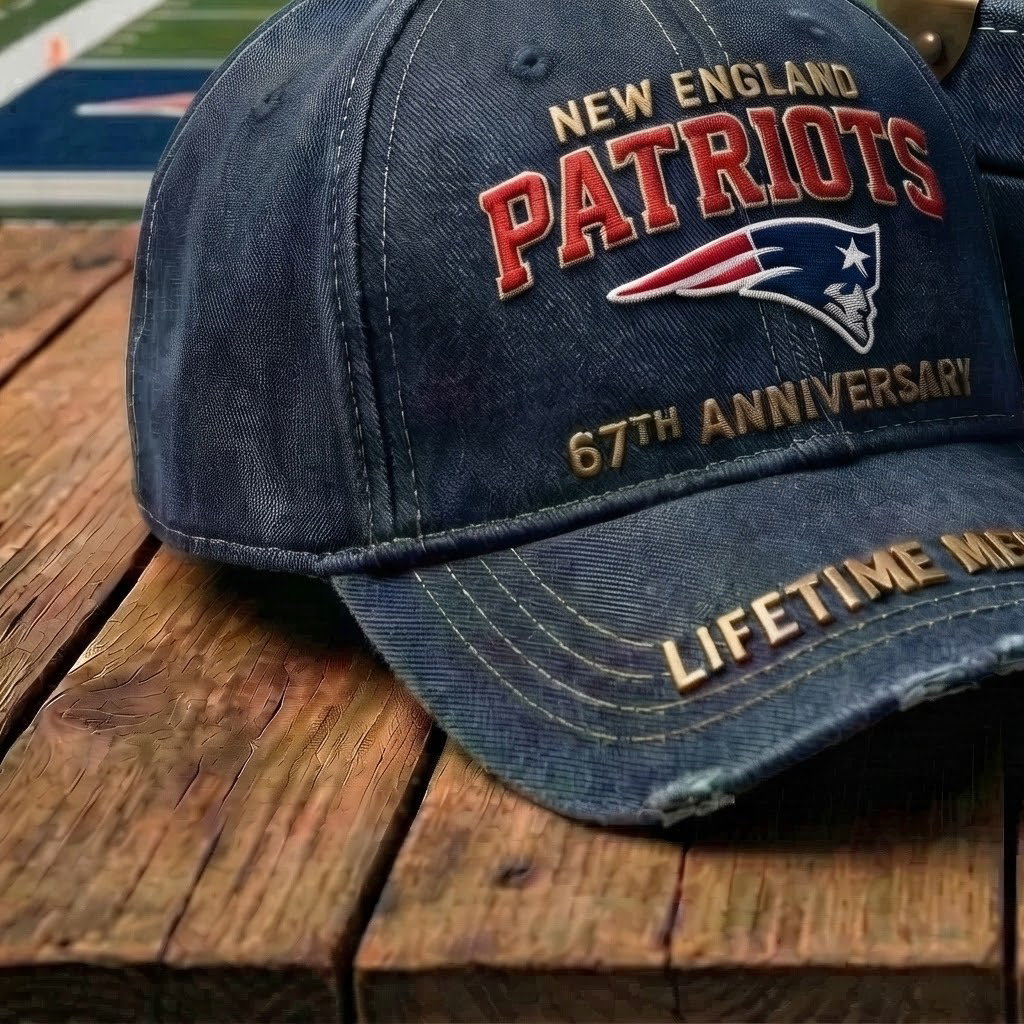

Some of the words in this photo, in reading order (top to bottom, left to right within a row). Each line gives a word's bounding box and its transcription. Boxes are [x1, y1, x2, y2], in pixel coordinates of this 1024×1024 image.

[548, 78, 655, 144] NEW
[669, 59, 860, 108] ENGLAND
[478, 103, 946, 301] PATRIOTS
[568, 405, 684, 478] 67TH
[700, 357, 972, 445] ANNIVERSARY
[661, 540, 949, 694] LIFETIME
